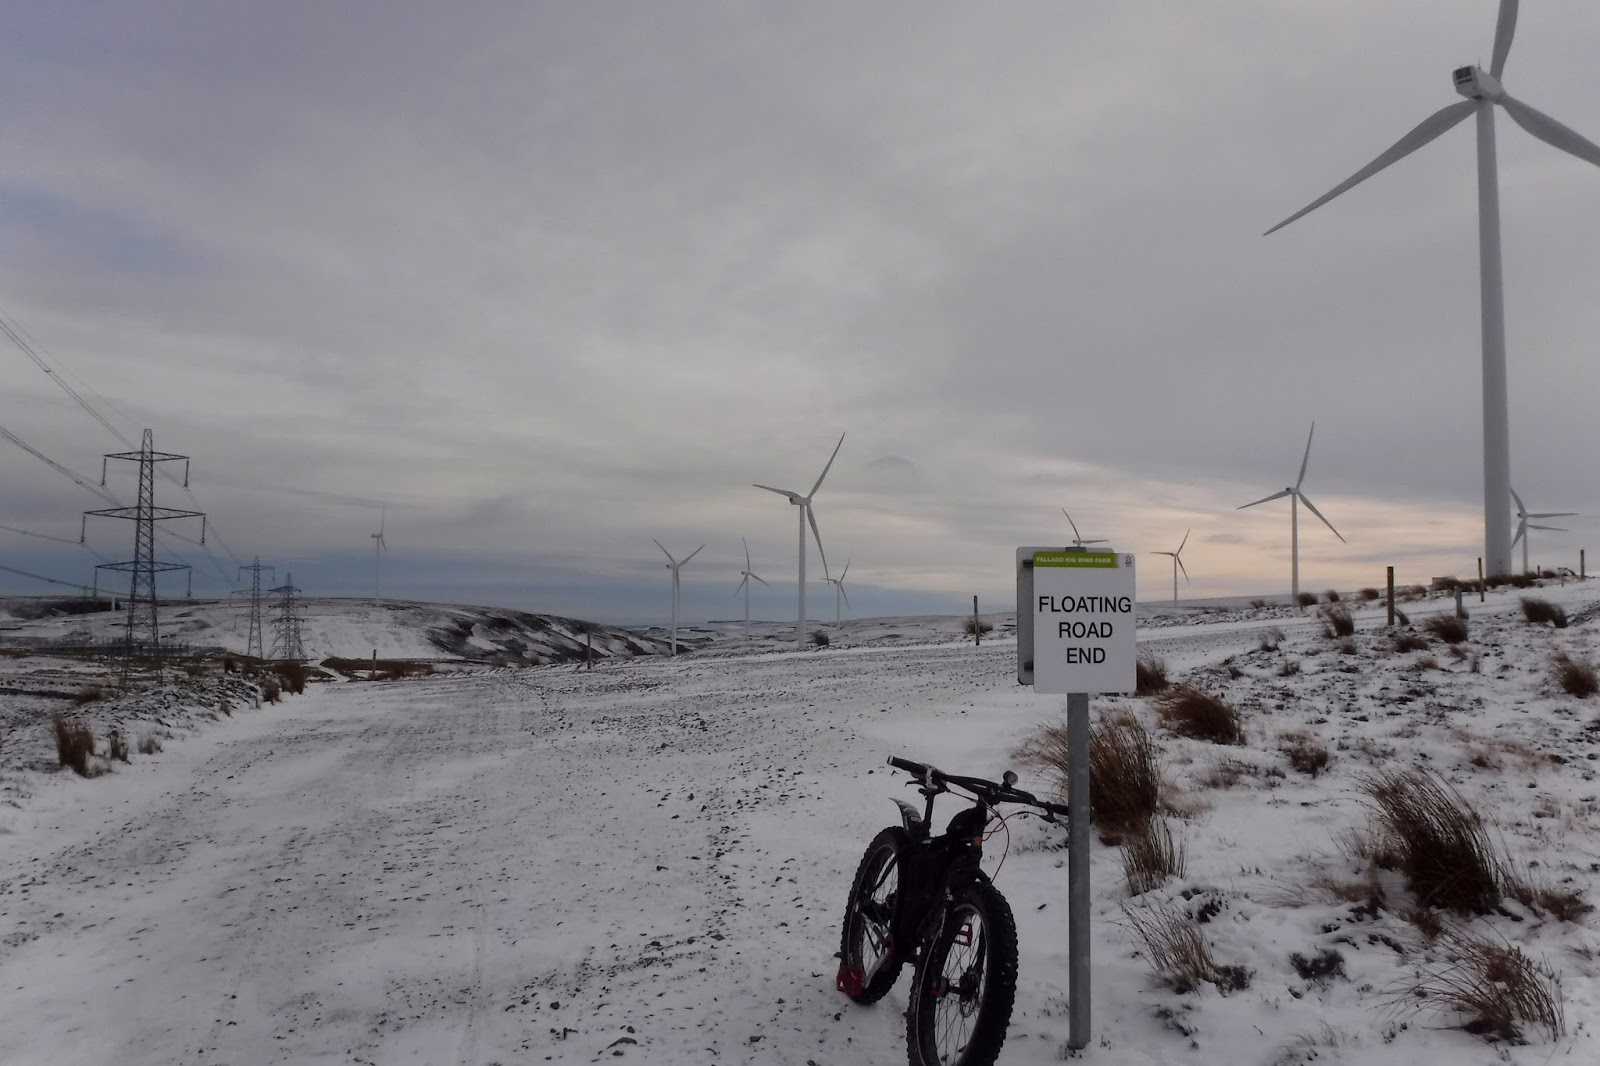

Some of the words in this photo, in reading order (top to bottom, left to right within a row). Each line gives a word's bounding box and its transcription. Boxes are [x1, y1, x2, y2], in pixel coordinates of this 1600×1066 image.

[1038, 596, 1132, 613] FLOATING
[1058, 622, 1113, 638] ROAD
[1066, 647, 1106, 664] END
